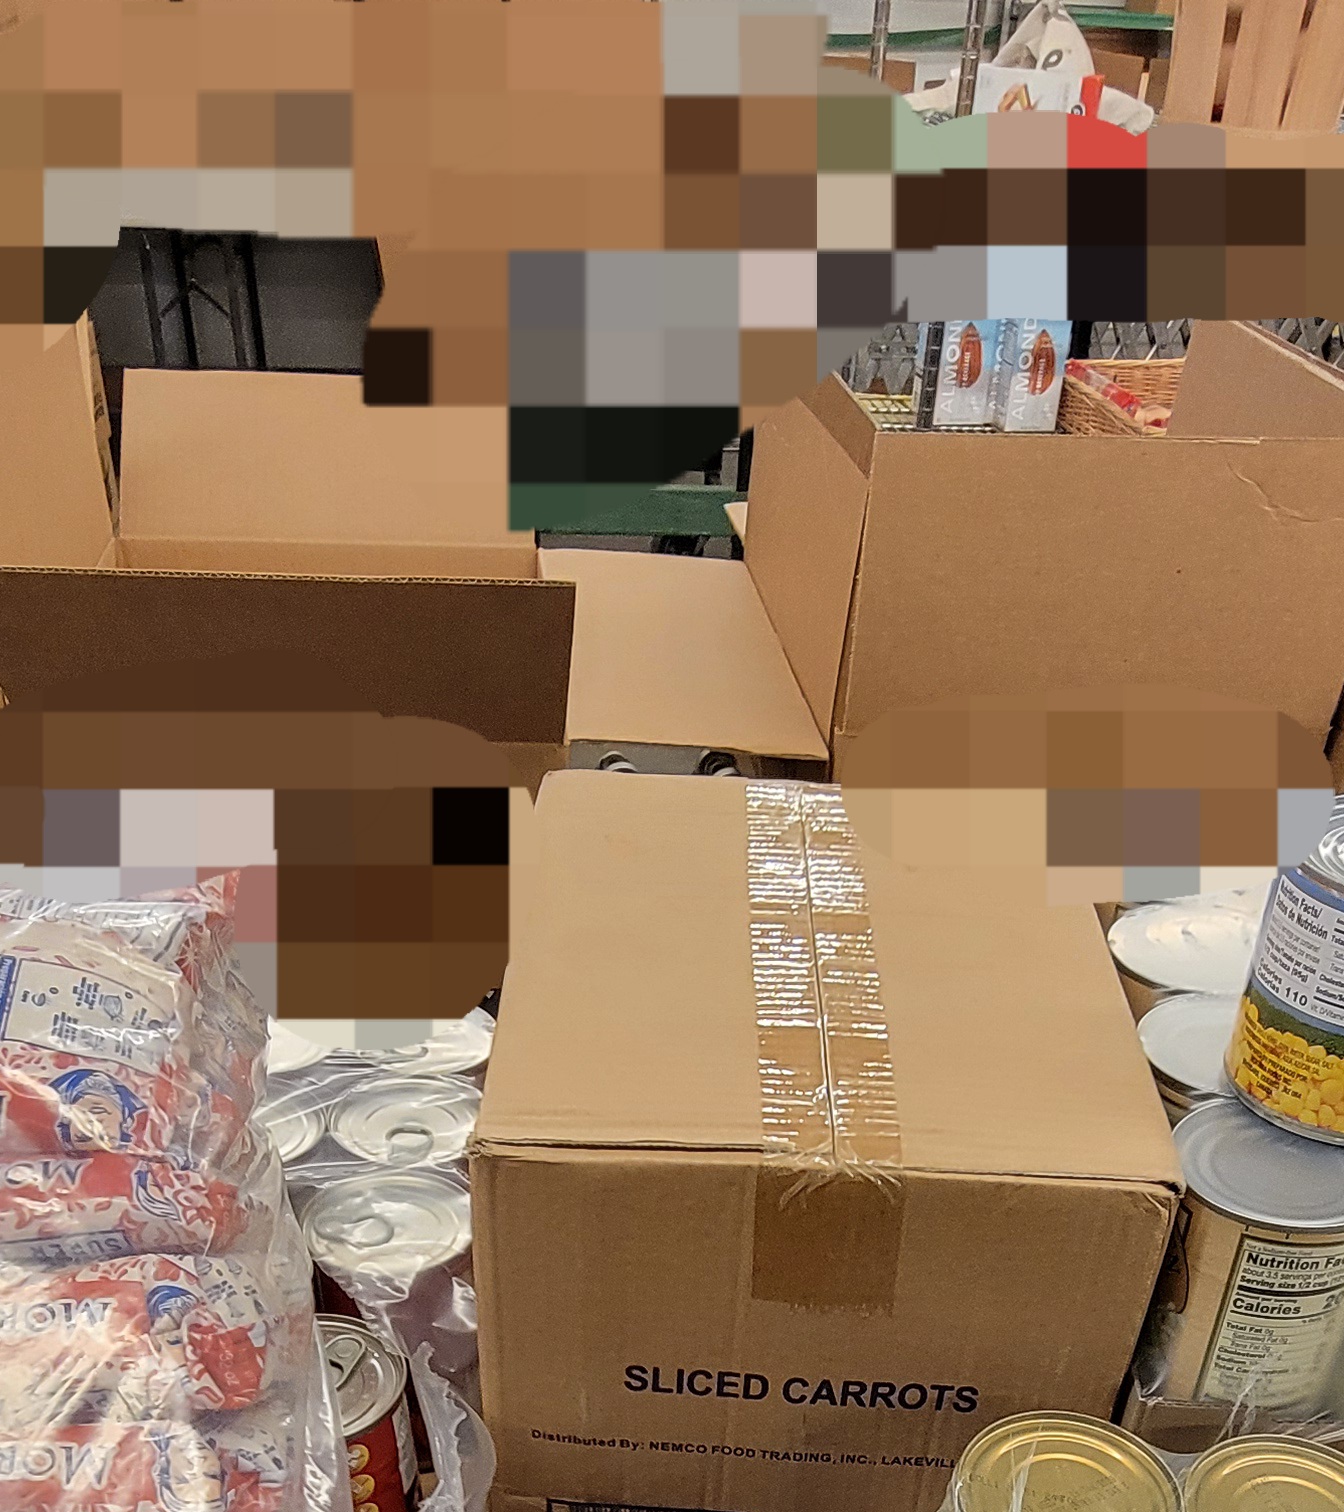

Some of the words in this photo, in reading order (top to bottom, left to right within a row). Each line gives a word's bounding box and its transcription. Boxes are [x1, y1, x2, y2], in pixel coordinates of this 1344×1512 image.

[1296, 913, 1328, 940] Nutrición
[1285, 986, 1308, 1006] 110
[1246, 1252, 1320, 1271] Nutrition
[1240, 1275, 1276, 1289] Serving
[1277, 1280, 1296, 1289] size
[1242, 1267, 1264, 1279] about
[1265, 1270, 1279, 1280] 3.5
[1232, 1298, 1302, 1316] Calories
[1226, 1321, 1247, 1333] Total
[1248, 1326, 1263, 1334] Fat
[1218, 1345, 1267, 1359] Cholesterol
[623, 1364, 769, 1401] SLICED
[781, 1376, 980, 1414] CARROTS
[531, 1429, 617, 1448] Distributed
[619, 1438, 645, 1451] By:
[649, 1441, 708, 1455] NEMCO
[711, 1445, 756, 1459] FOOD
[760, 1449, 838, 1465] TRADING,
